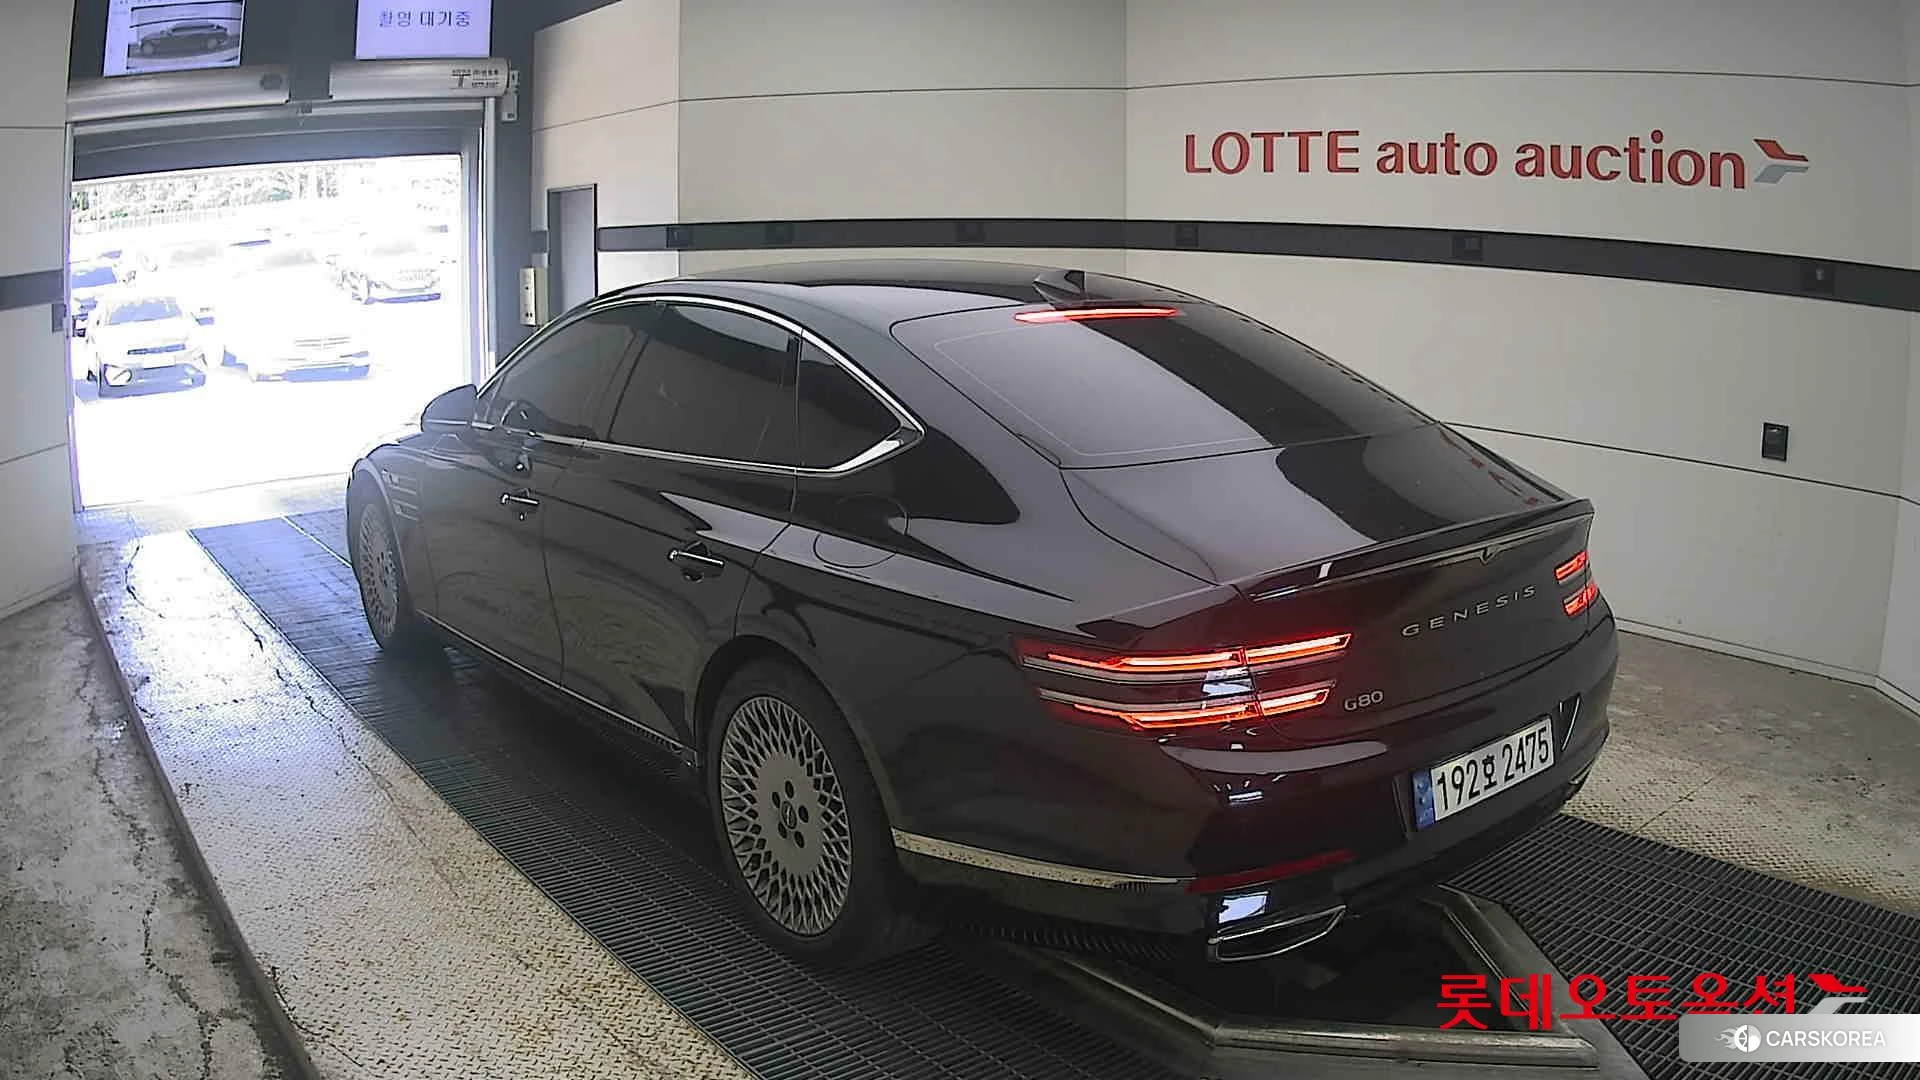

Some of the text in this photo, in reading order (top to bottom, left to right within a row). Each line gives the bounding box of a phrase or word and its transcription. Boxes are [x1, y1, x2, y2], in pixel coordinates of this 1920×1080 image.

[420, 10, 472, 28] 대기중
[1186, 130, 1745, 188] LOTTE auto auction
[1402, 585, 1536, 637] GENESIS
[1344, 690, 1384, 711] G80
[1437, 727, 1550, 811] 192호 2475
